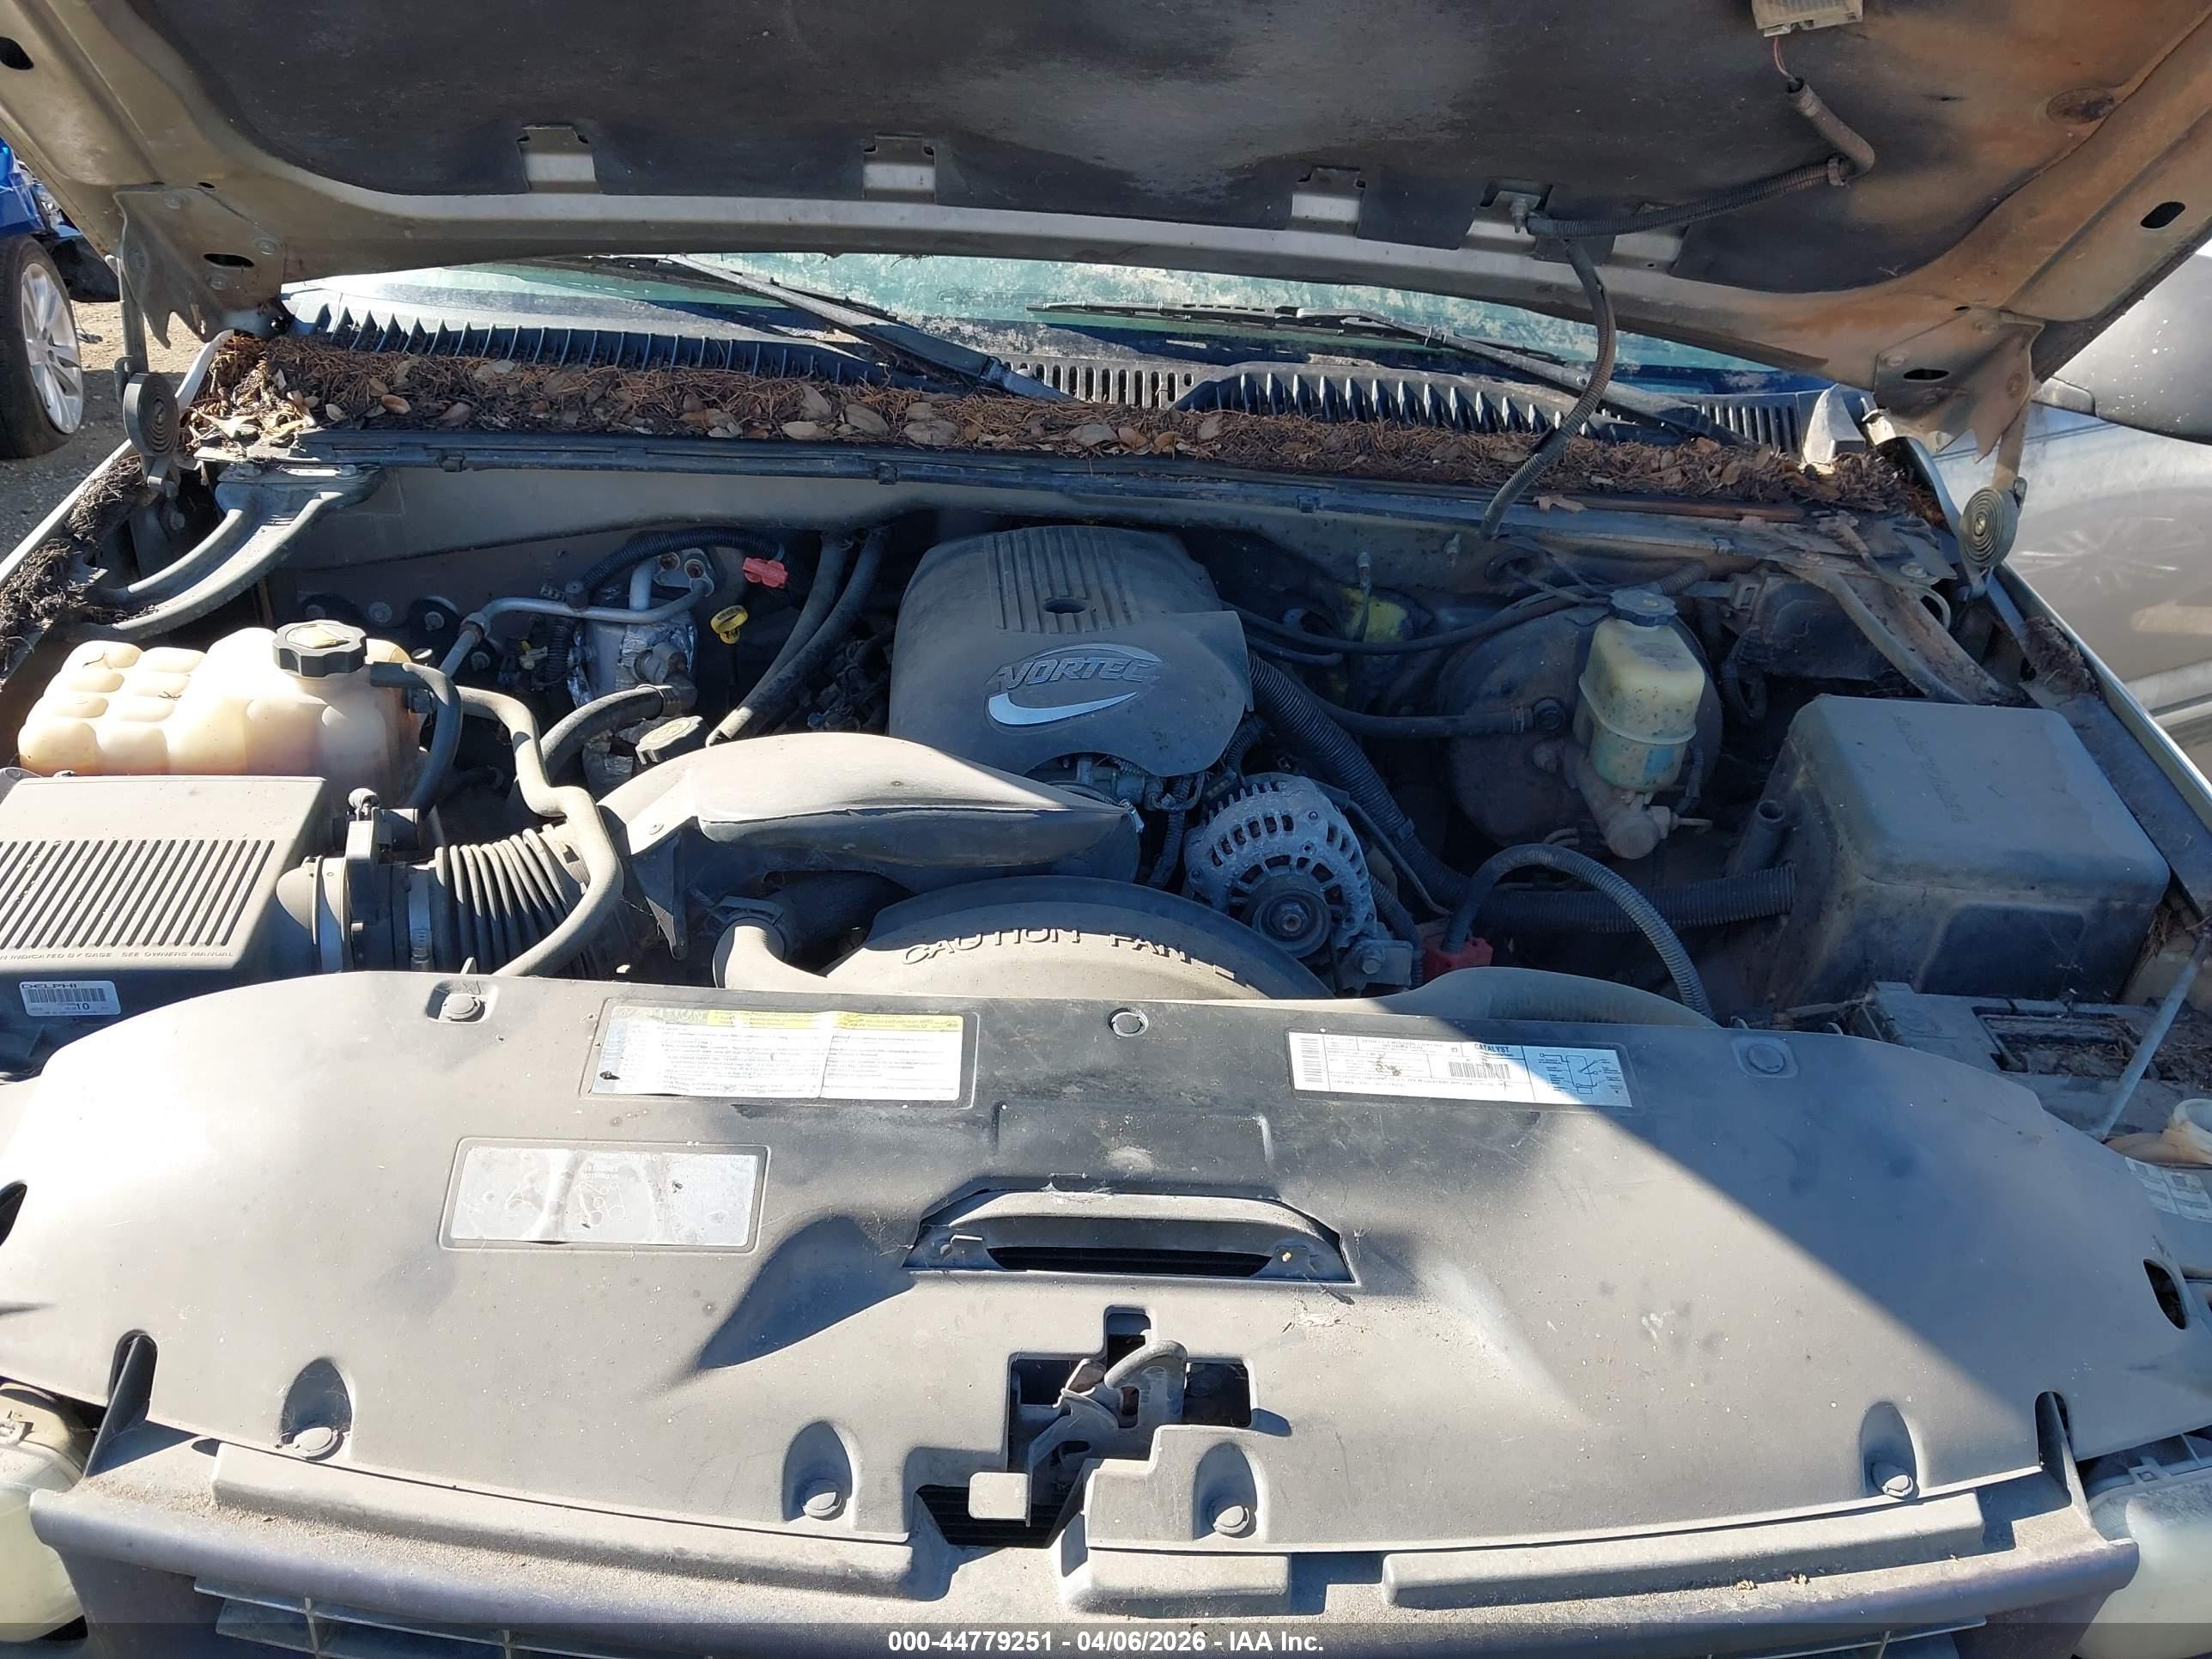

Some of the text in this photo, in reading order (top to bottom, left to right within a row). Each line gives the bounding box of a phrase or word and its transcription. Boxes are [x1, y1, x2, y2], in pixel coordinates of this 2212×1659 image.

[996, 656, 1152, 690] VORTEC
[902, 927, 1082, 965] CAUTION
[1474, 1043, 1510, 1053] CATALYST
